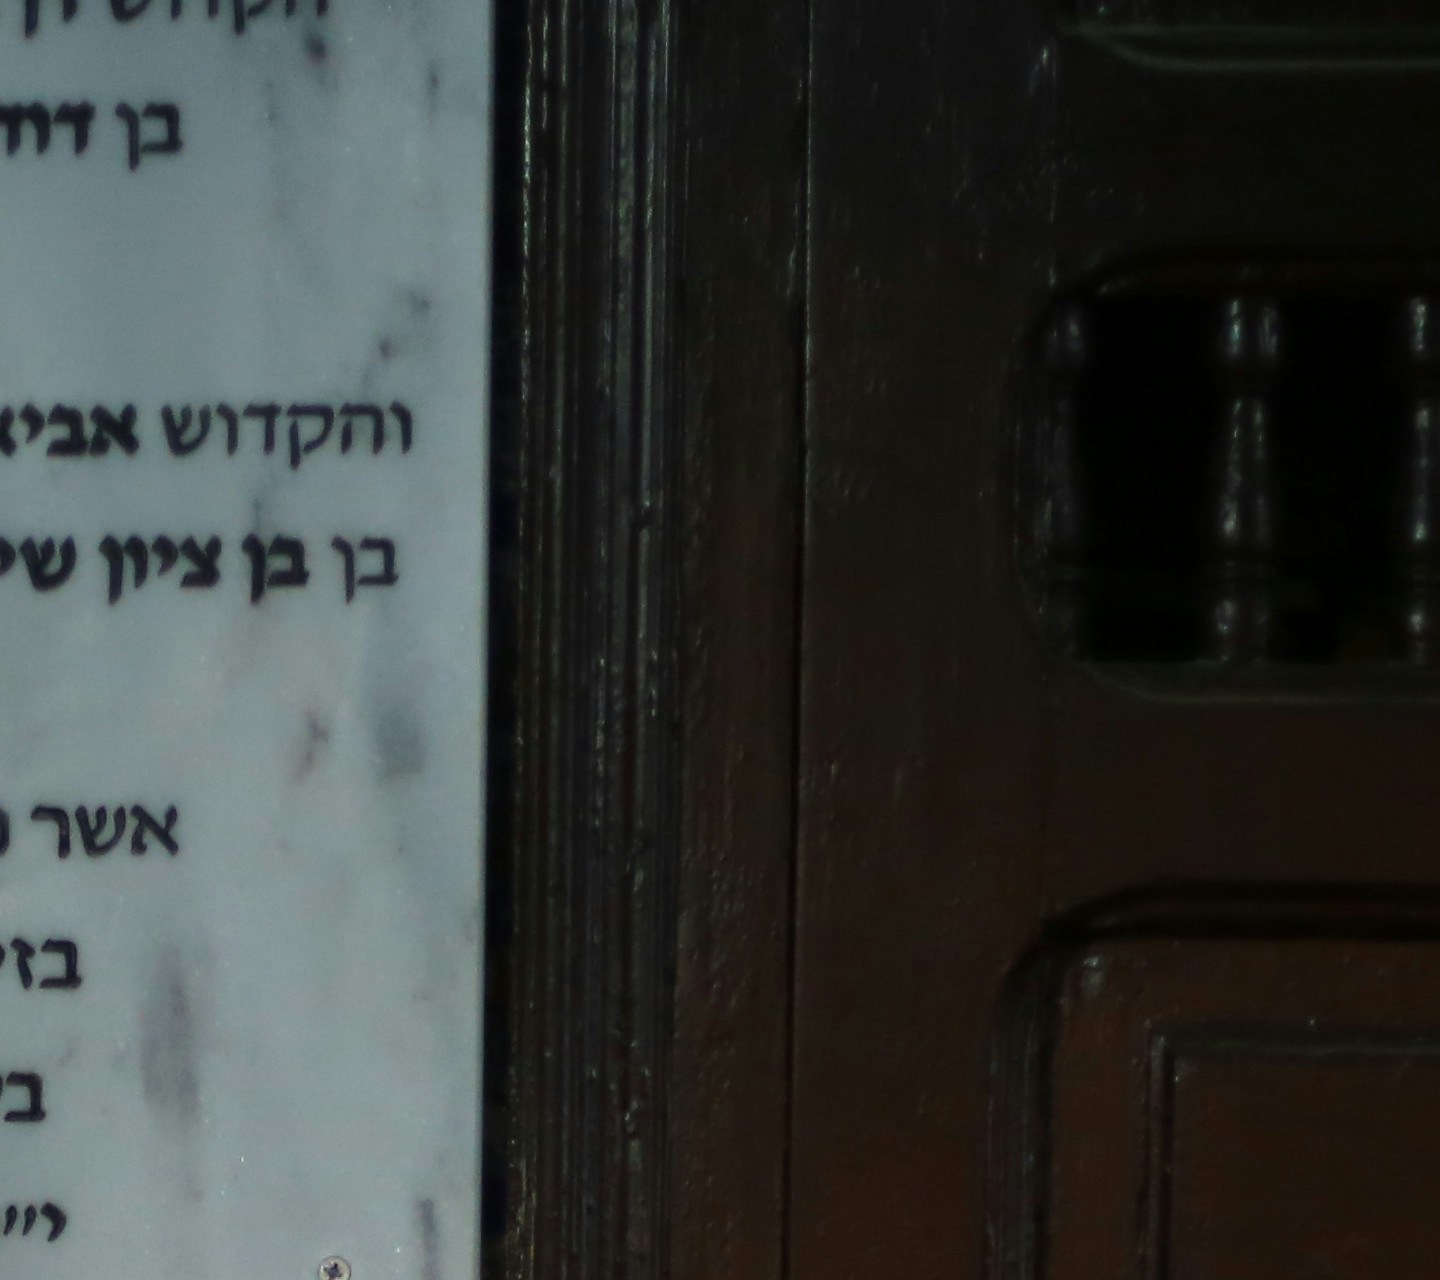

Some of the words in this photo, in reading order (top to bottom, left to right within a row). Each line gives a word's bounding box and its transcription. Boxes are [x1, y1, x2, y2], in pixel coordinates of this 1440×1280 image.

[113, 100, 185, 173] בן
[159, 400, 414, 471] והקדוש
[97, 533, 223, 606] ציון
[240, 531, 311, 607] בן
[329, 534, 400, 605] בן
[29, 802, 181, 860] אשר
